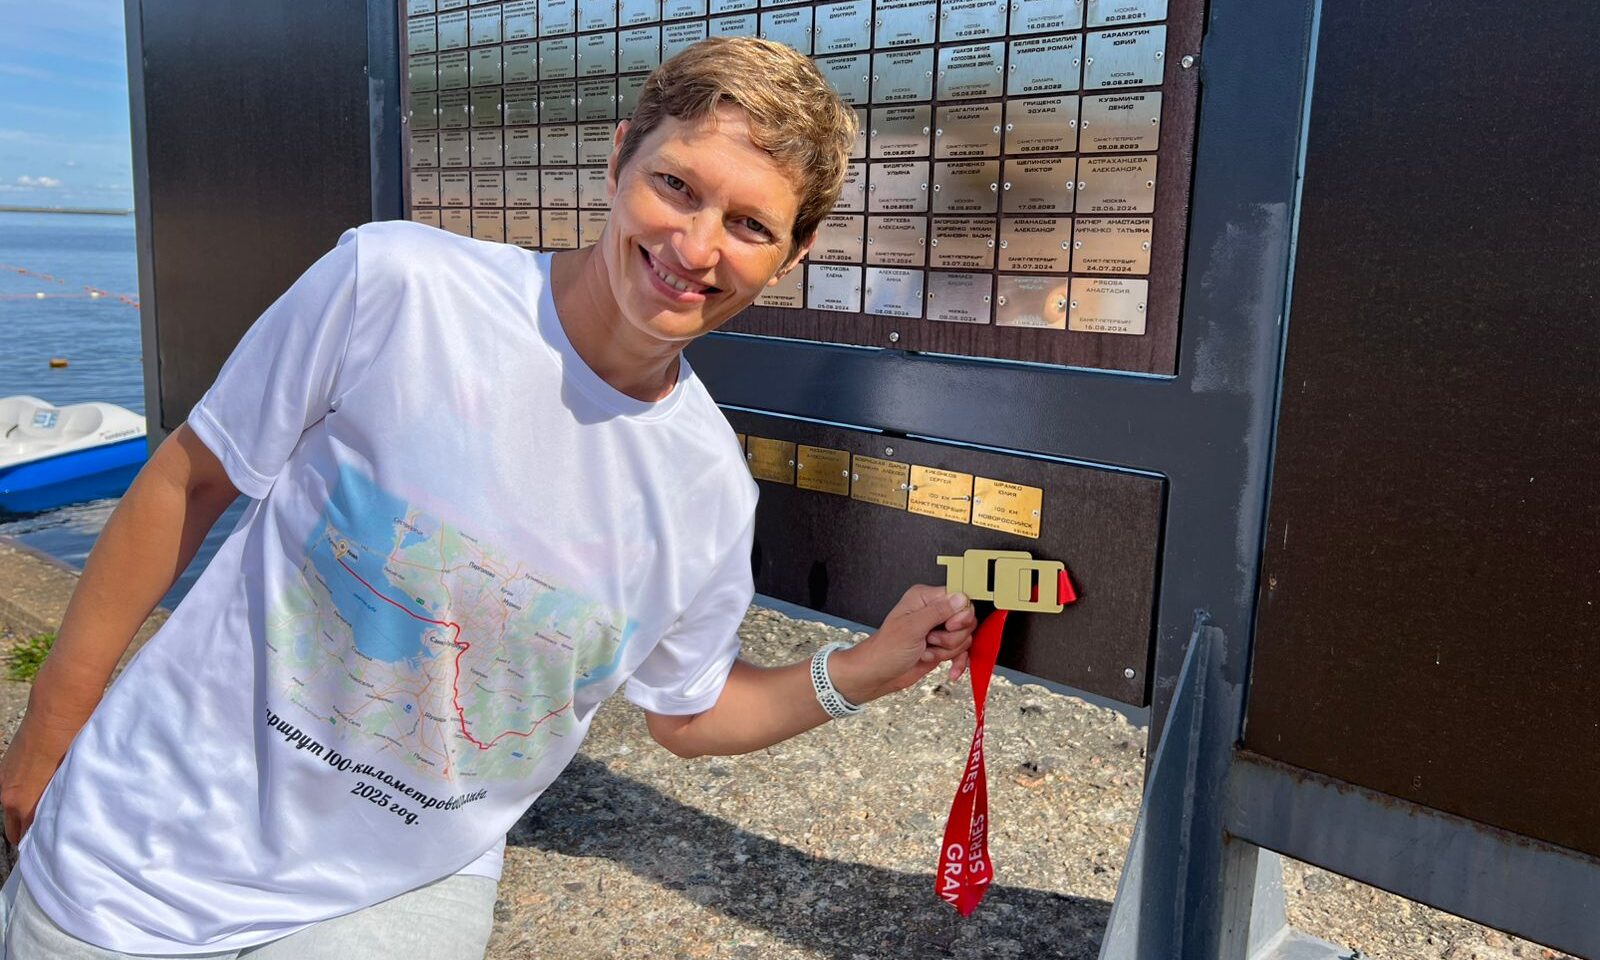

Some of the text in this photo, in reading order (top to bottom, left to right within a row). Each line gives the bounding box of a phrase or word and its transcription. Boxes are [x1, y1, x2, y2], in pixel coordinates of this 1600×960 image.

[1101, 30, 1150, 39] САРАМУТИН
[1013, 35, 1077, 47] БЕЛЯЕВ ВАСИЛИЙ
[1098, 95, 1145, 103] КУЗЬМИЧЕВ
[1087, 157, 1148, 165] АСТРАХАНЦЕВА
[994, 481, 1023, 492] ШРАМКО
[998, 490, 1017, 498] ЮЛИЯ
[978, 513, 1033, 529] НОВОРОССИЙСК
[266, 708, 324, 757] ршрут
[351, 781, 419, 826] 2025 год.
[968, 814, 985, 875] SERIES
